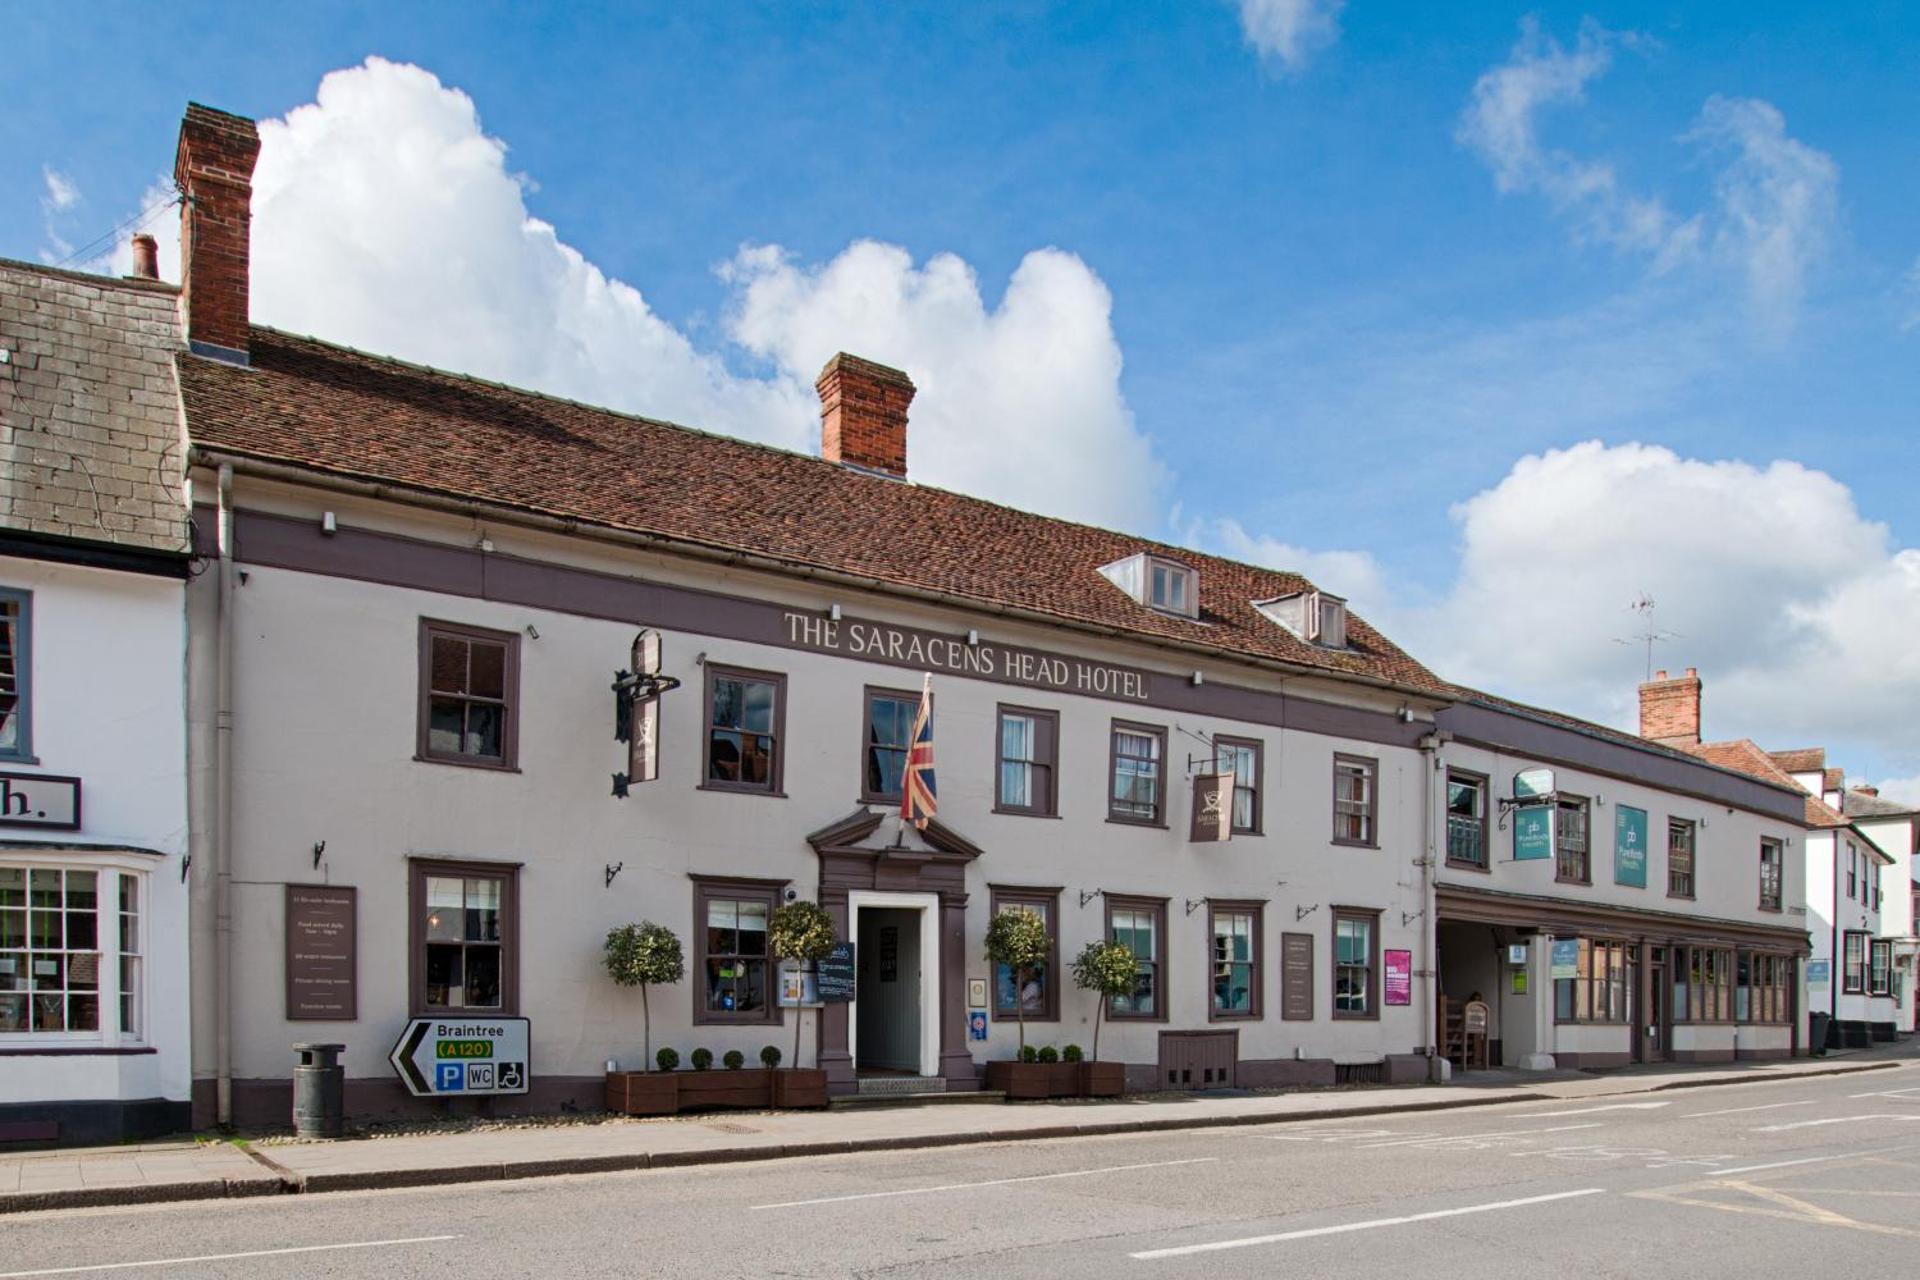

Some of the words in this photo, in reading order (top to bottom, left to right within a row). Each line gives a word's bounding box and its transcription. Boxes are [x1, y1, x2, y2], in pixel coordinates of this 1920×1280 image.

[784, 612, 840, 649] THE
[849, 624, 995, 674] SARACENS
[1003, 650, 1069, 685] HEAD
[1076, 663, 1148, 699] HOTEL
[437, 1024, 504, 1037] Braintree
[443, 1066, 459, 1088] P
[470, 1069, 491, 1084] WC
